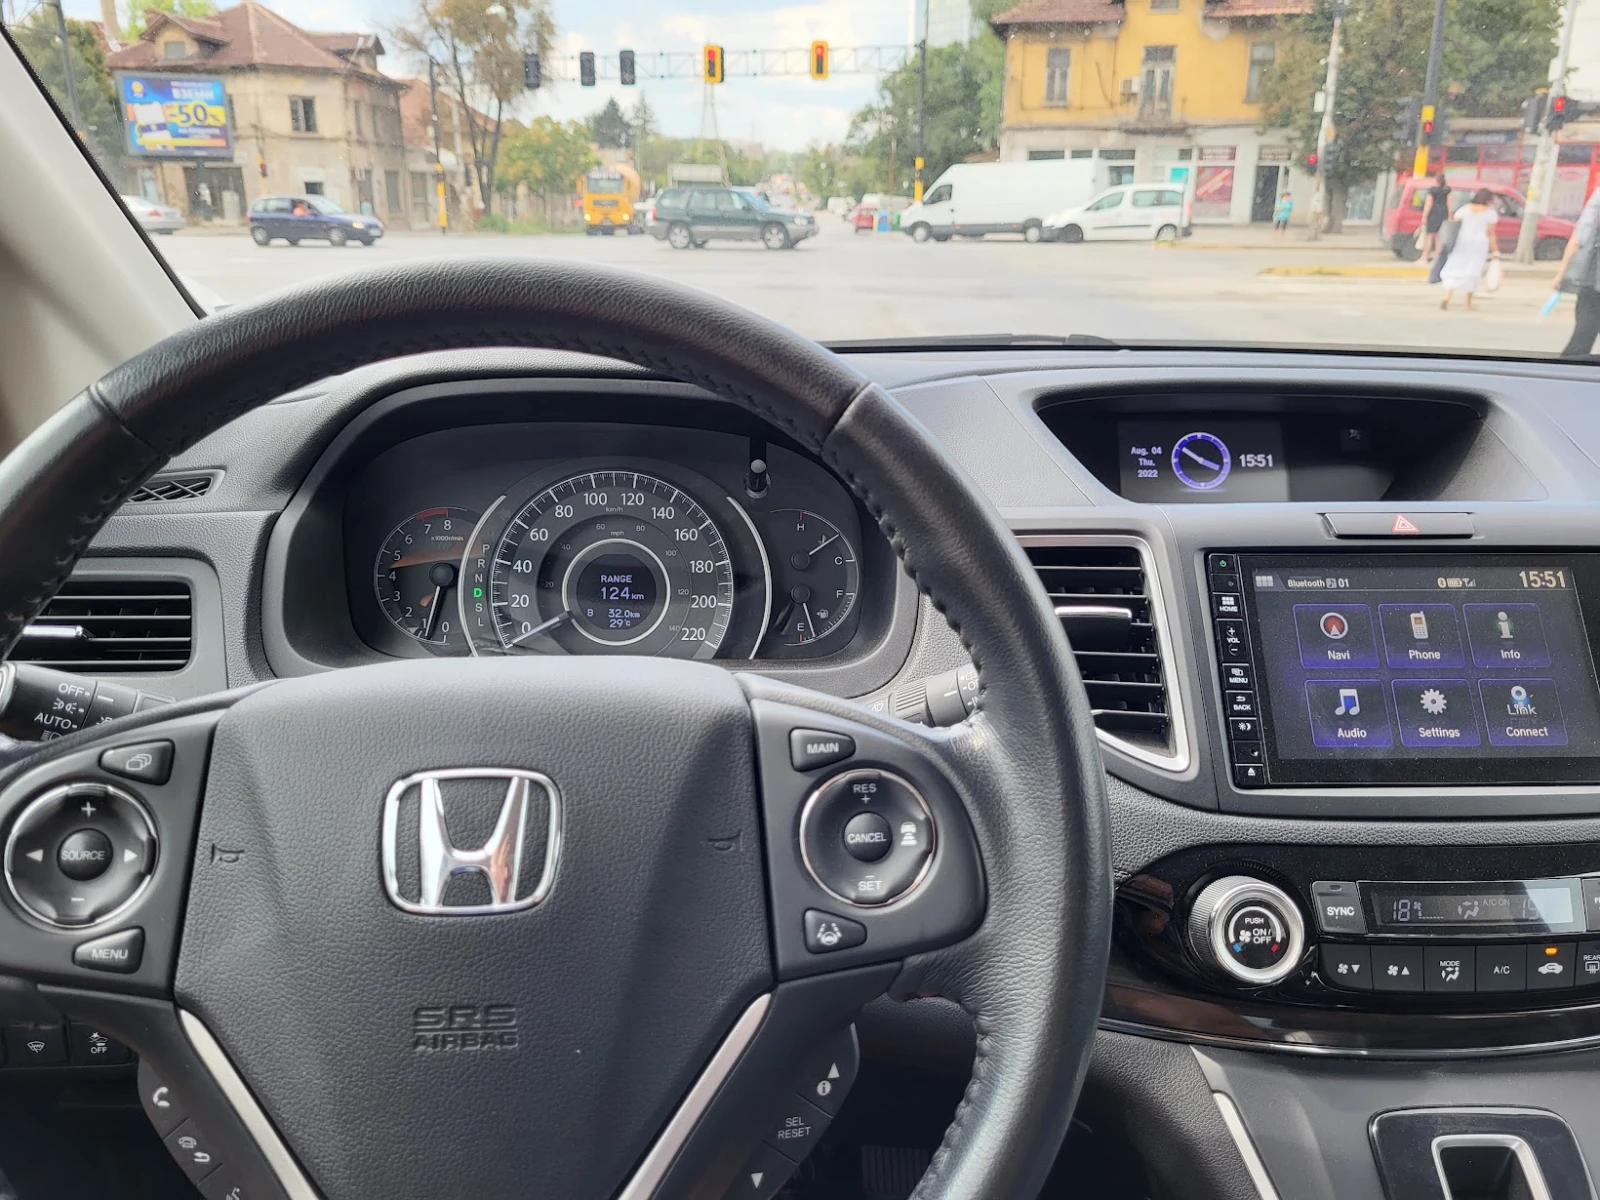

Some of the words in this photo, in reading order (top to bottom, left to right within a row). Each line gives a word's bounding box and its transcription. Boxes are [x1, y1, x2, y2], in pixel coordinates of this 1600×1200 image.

[1130, 446, 1148, 455] Aug.
[1138, 458, 1155, 466] Thu.
[1239, 454, 1273, 467] 15:51
[1137, 469, 1158, 477] 2022
[583, 493, 607, 505] 100
[621, 493, 644, 505] 120
[554, 505, 573, 517] 80
[651, 507, 674, 519] 140
[424, 524, 431, 534] 7
[443, 520, 451, 530] 8
[797, 523, 804, 531] H
[405, 535, 412, 544] 6
[530, 528, 548, 541] 60
[674, 528, 698, 541] 160
[482, 544, 490, 553] P
[394, 550, 400, 560] 5
[477, 559, 485, 568] R
[834, 556, 842, 565] C
[513, 560, 532, 573] 40
[689, 560, 713, 573] 180
[388, 571, 396, 580] 4
[475, 574, 482, 582] N
[600, 575, 632, 583] RANGE
[1519, 571, 1566, 588] 15:51
[1287, 579, 1325, 588] Bluetooth
[1338, 578, 1349, 587] 01
[393, 591, 400, 601] 3
[473, 588, 482, 597] D
[601, 586, 629, 599] 124
[836, 590, 843, 598] F
[511, 594, 529, 607] 20
[691, 595, 716, 608] 200
[405, 606, 412, 617] 2
[475, 603, 482, 612] S
[442, 621, 449, 632] 0
[478, 617, 484, 626] L
[797, 622, 804, 631] E
[521, 621, 530, 633] 0
[681, 627, 705, 640] 220
[1328, 650, 1350, 660] Navi
[1408, 649, 1440, 659] Phone
[1500, 649, 1520, 659] Info
[58, 683, 84, 697] OFF
[34, 712, 72, 729] AUTO
[1337, 728, 1367, 738] Audio
[1418, 727, 1460, 738] Settings
[1506, 726, 1548, 737] Connect
[807, 742, 839, 754] MAIN
[853, 783, 876, 793] RES
[847, 833, 887, 843] CANCEL
[61, 850, 105, 860] SOURCE
[858, 880, 882, 890] SET
[1327, 906, 1354, 916] SYNC
[1253, 936, 1271, 944] OFF
[91, 949, 128, 959] MENU
[1493, 966, 1510, 974] A/C
[414, 1006, 517, 1029] SRS
[413, 1032, 519, 1052] AIRBAG
[785, 1116, 804, 1127] SEL
[777, 1126, 811, 1139] RESET
